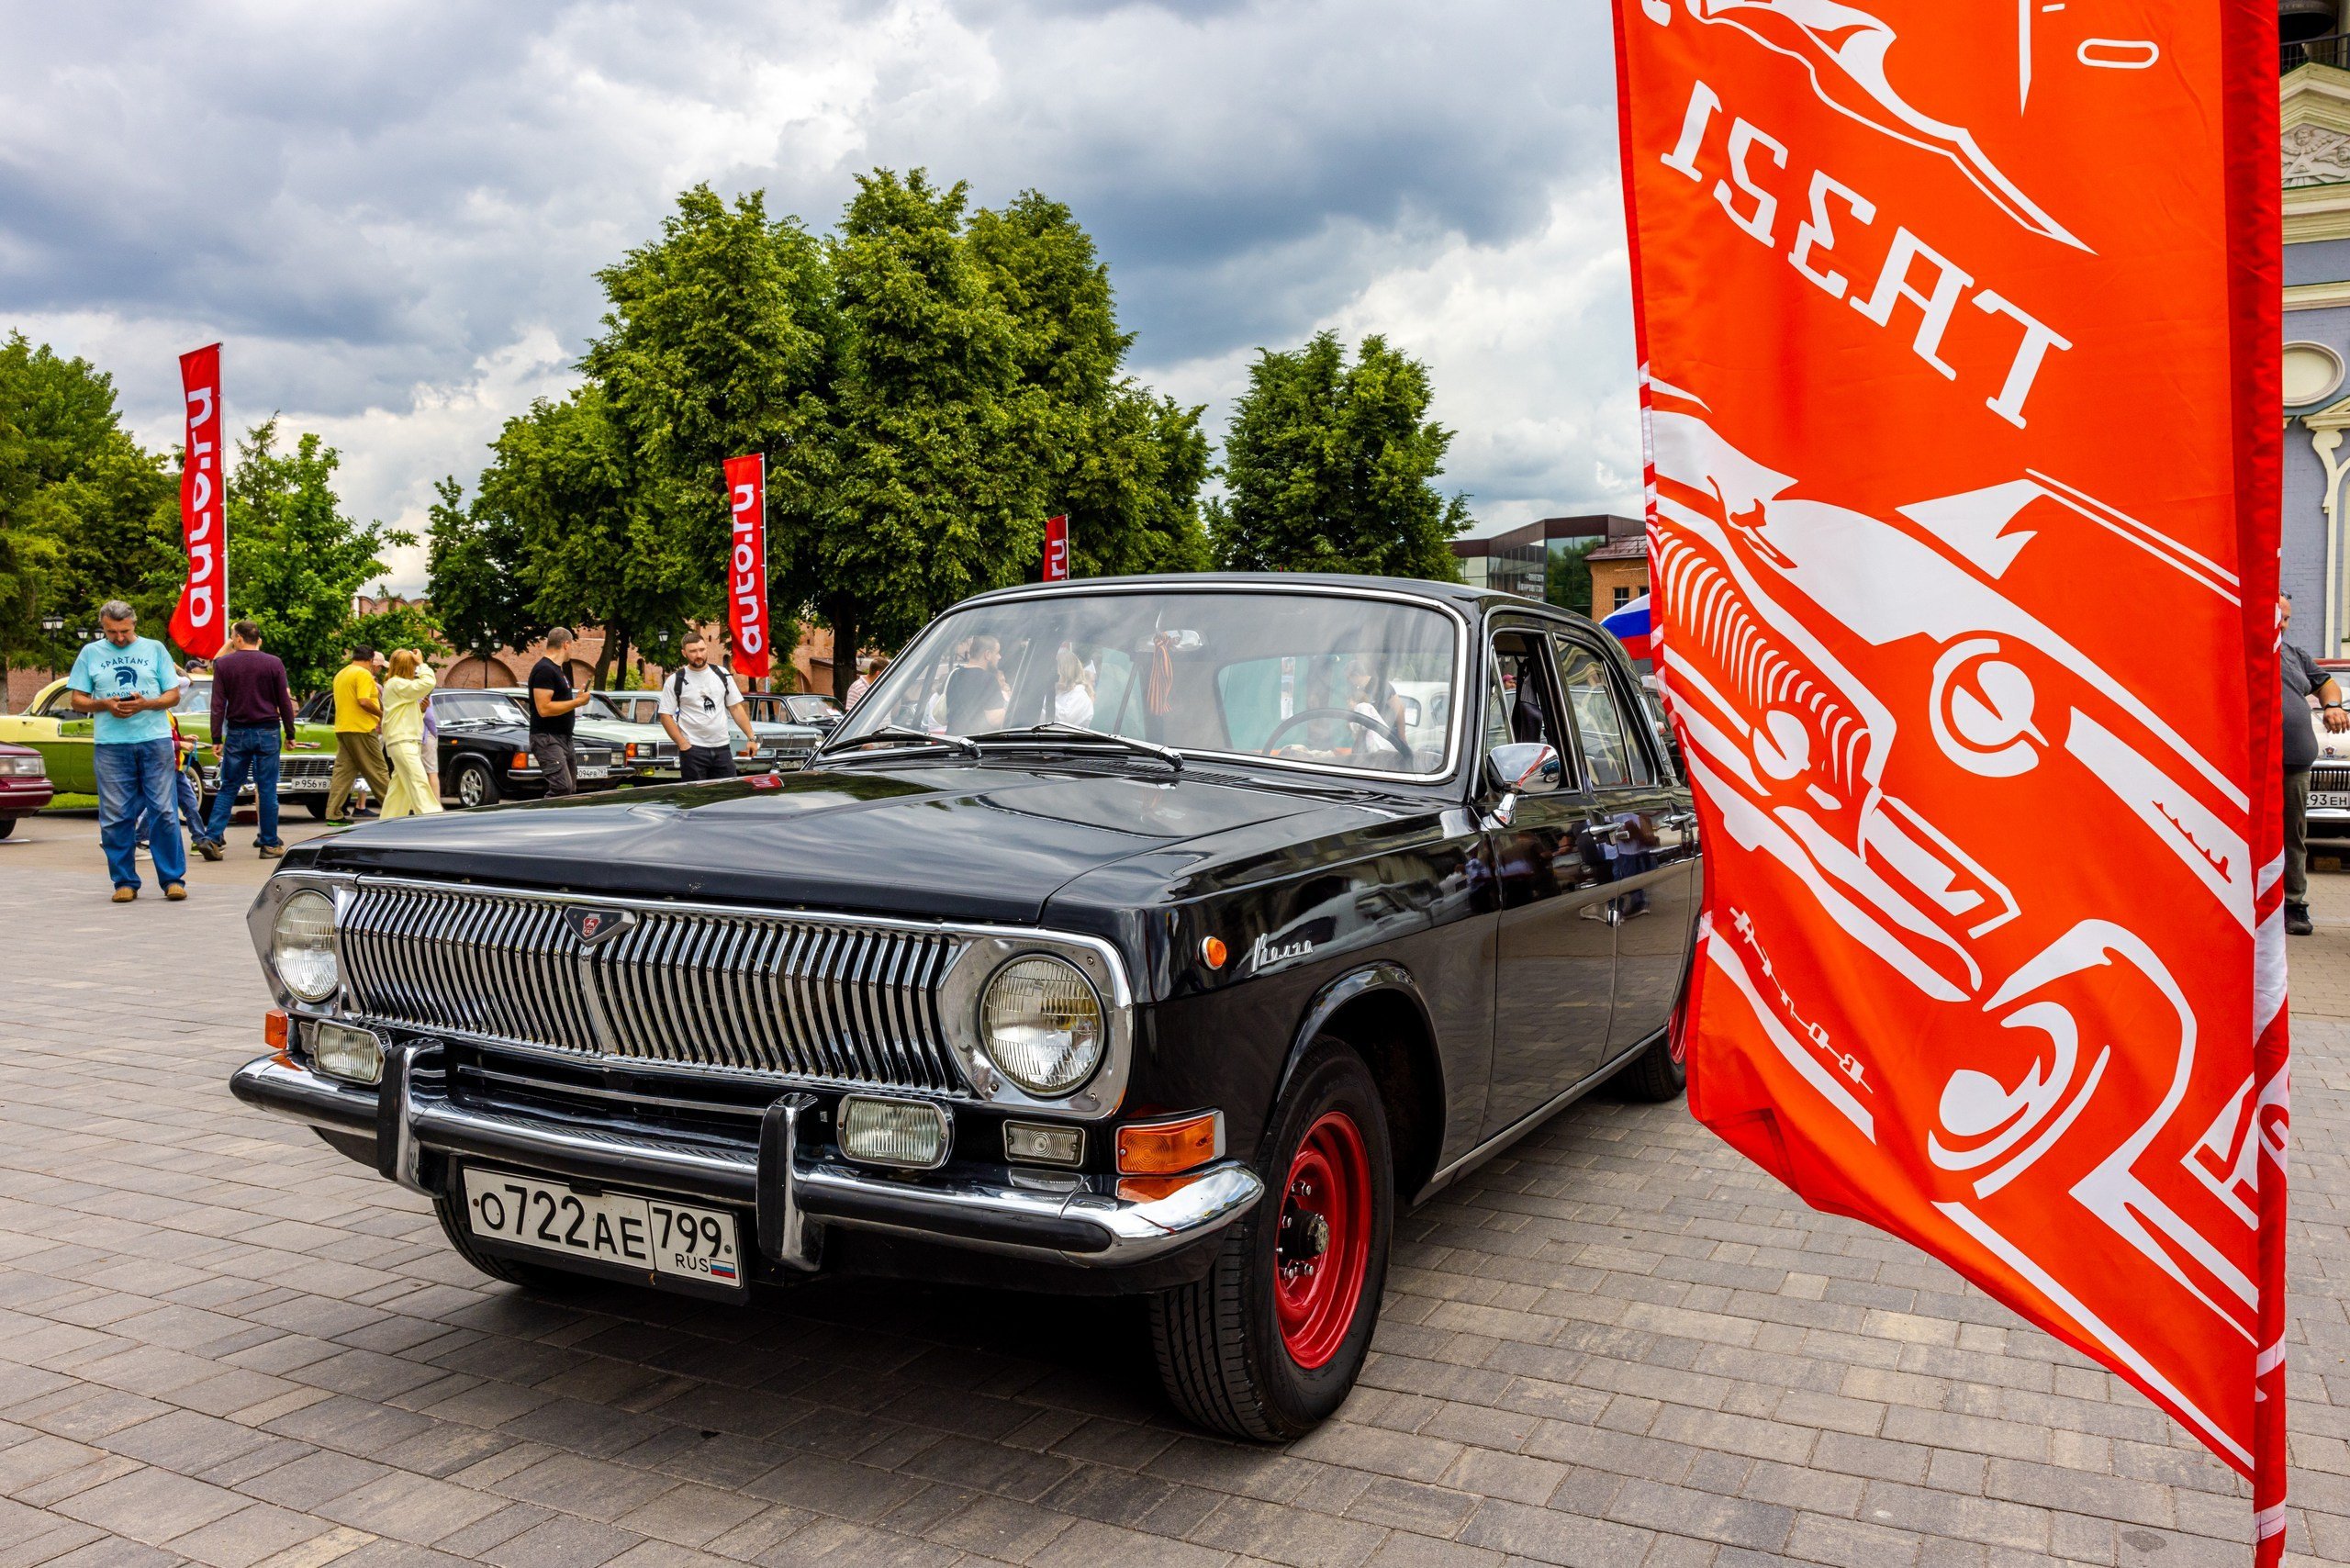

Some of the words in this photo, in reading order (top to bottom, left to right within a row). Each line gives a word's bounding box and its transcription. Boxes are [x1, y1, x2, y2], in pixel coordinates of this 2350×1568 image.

[187, 386, 213, 628] auto.ru
[733, 484, 762, 655] auto.ru
[101, 656, 149, 669] SPARTANS
[2306, 794, 2347, 806] 93ЕН
[480, 1183, 647, 1260] О722АЕ
[653, 1206, 722, 1259] 799
[675, 1253, 710, 1273] RUS
